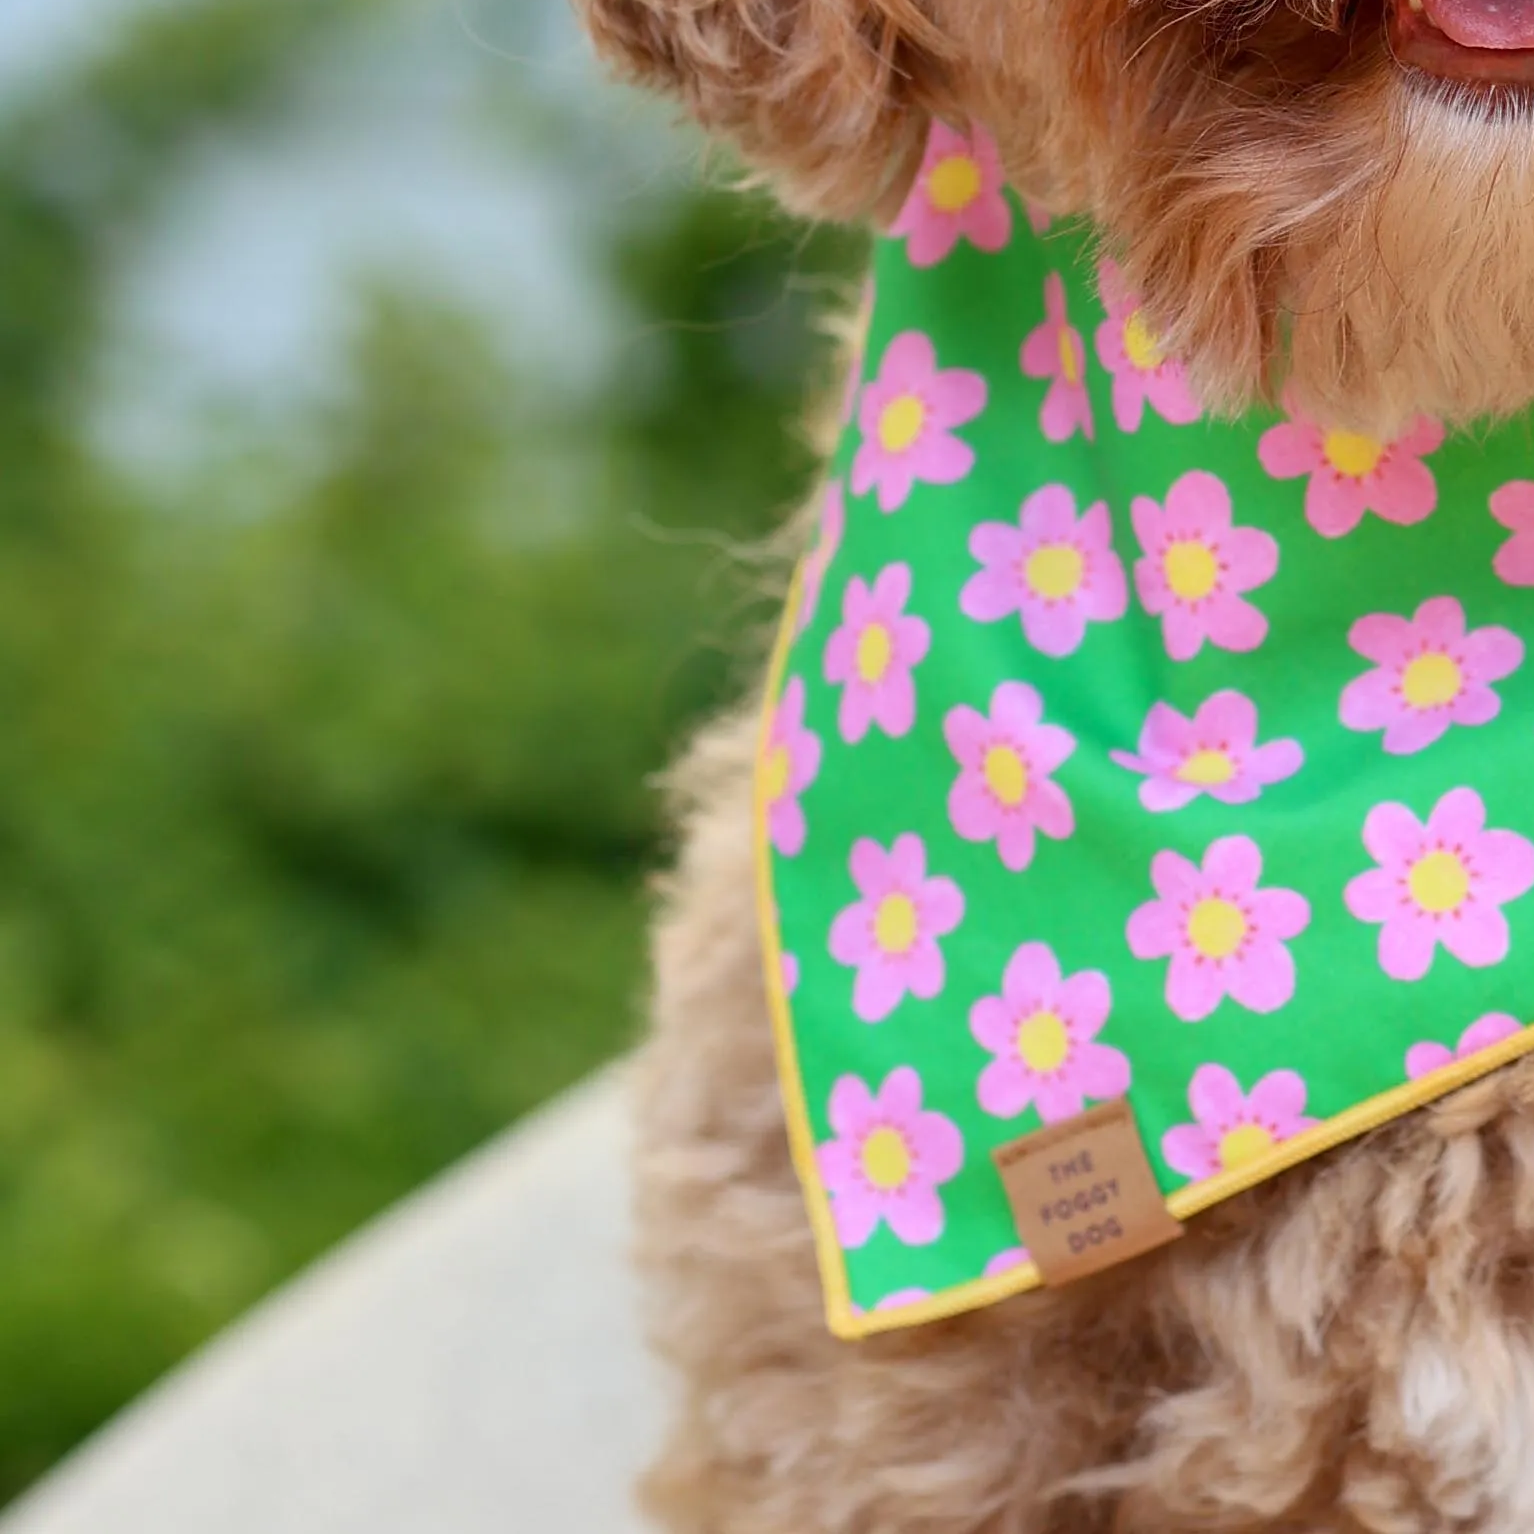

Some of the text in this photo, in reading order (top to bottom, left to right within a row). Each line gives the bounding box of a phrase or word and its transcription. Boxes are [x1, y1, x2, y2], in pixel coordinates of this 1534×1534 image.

[1048, 1150, 1093, 1184] THE
[1040, 1178, 1119, 1226] FOGGY
[1067, 1215, 1123, 1254] DOG
